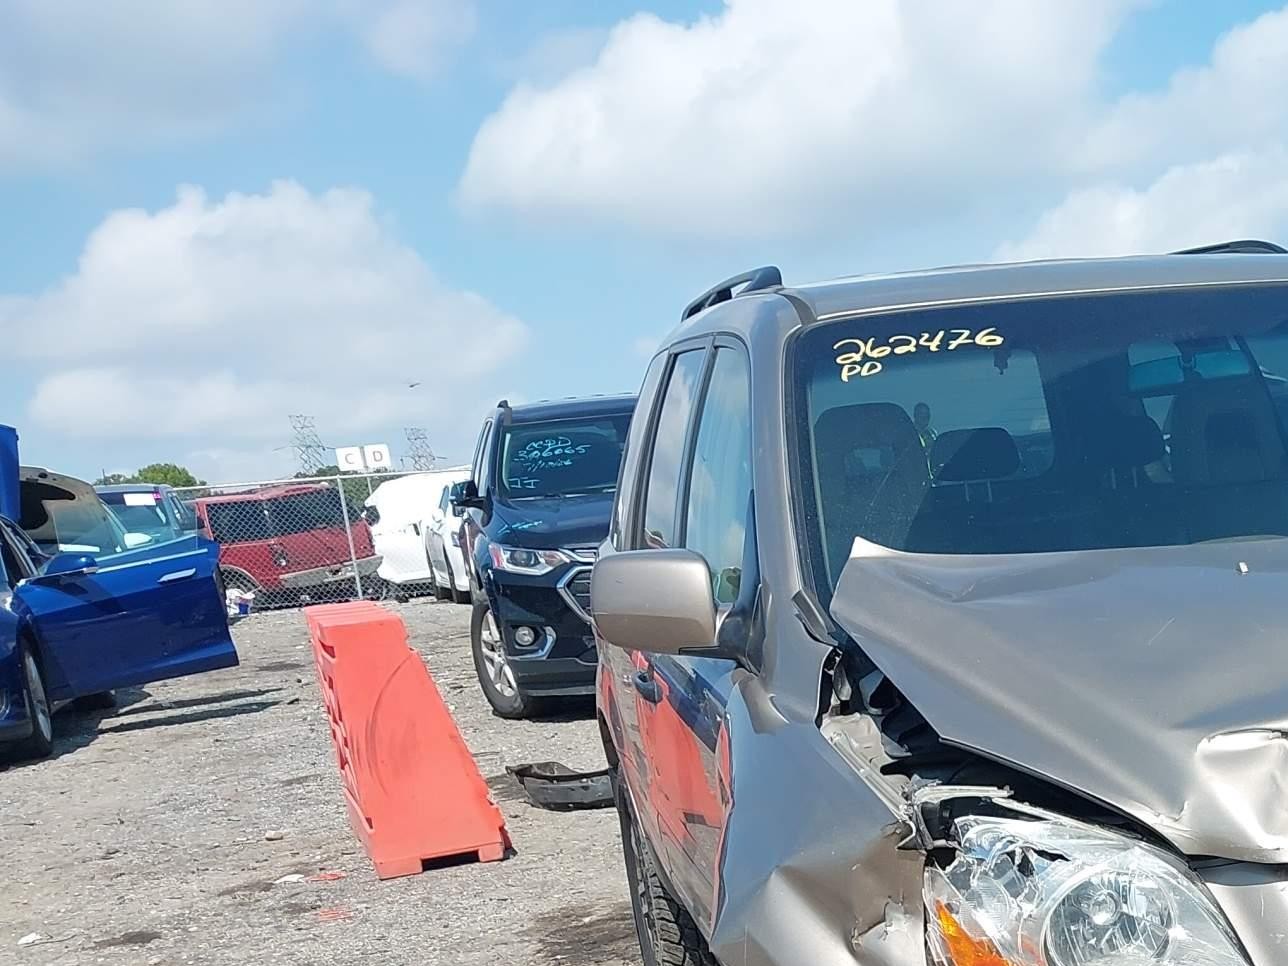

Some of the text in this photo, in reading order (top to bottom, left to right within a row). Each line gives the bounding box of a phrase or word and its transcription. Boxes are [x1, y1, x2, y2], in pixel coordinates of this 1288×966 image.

[833, 327, 1004, 364] 262476
[840, 361, 882, 382] PD
[344, 453, 355, 465] C
[372, 450, 383, 462] D
